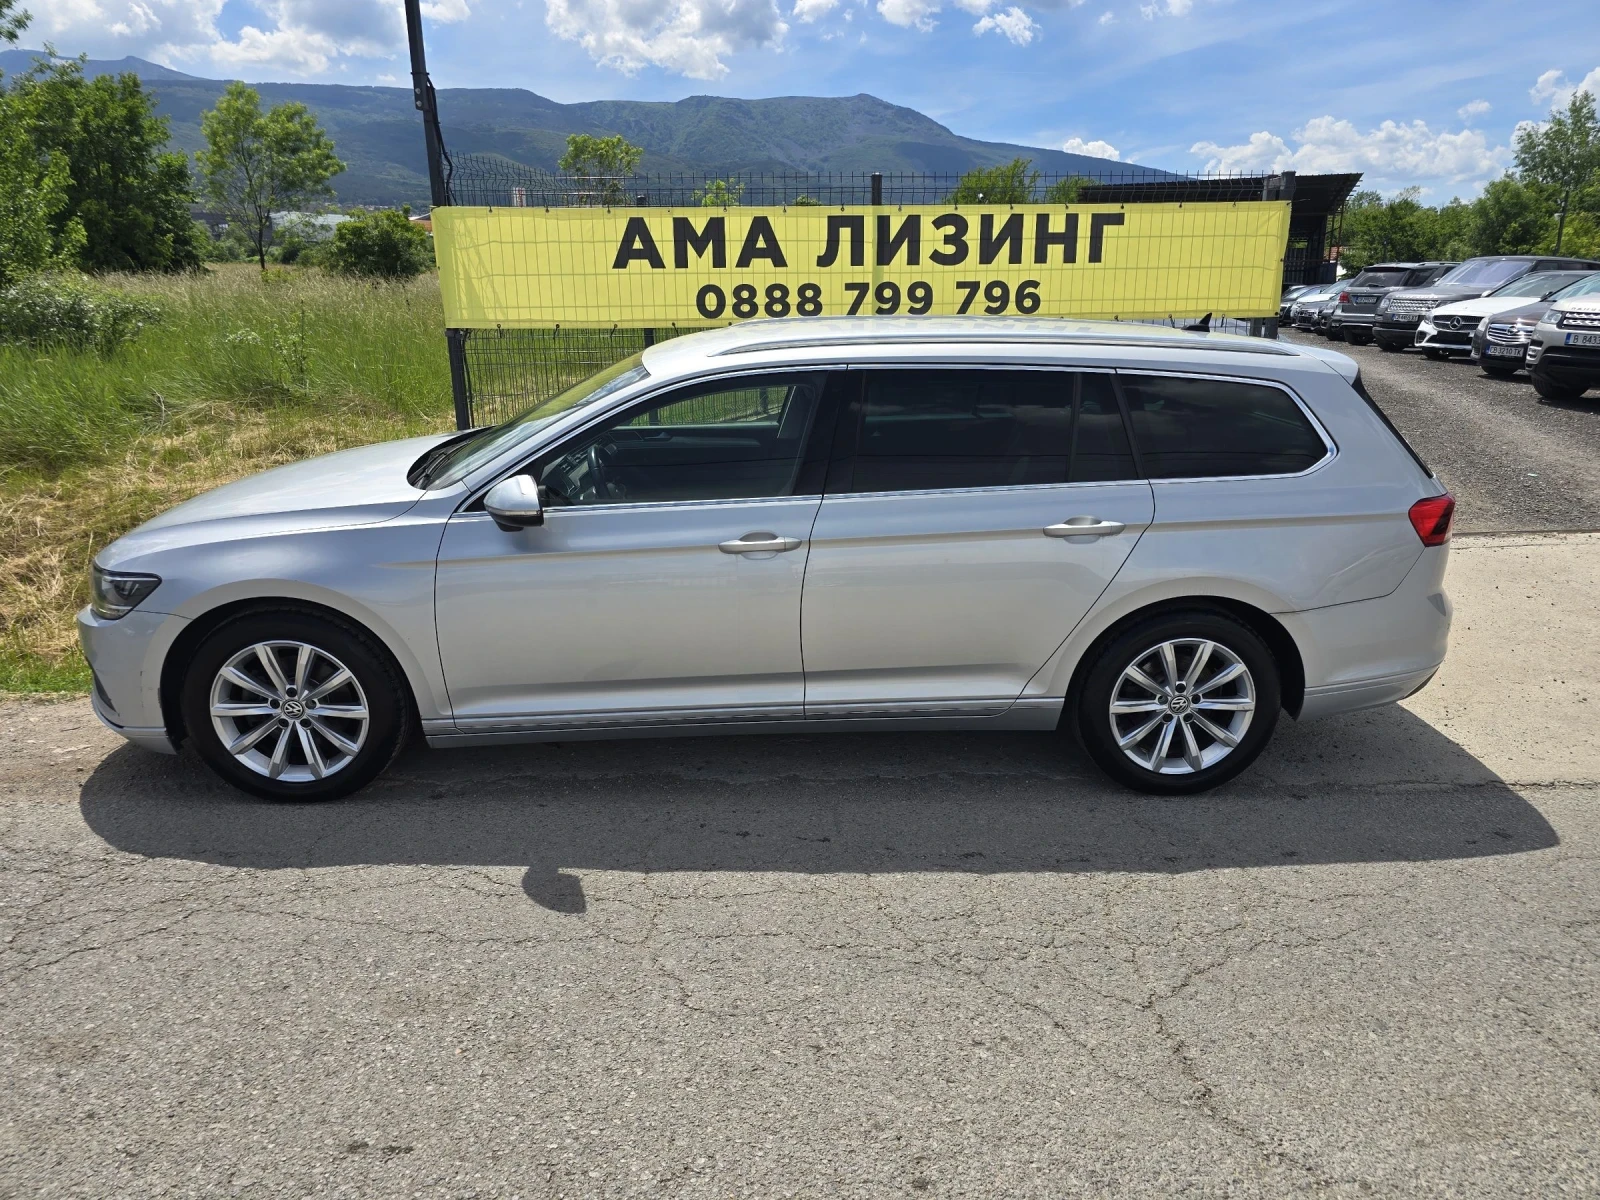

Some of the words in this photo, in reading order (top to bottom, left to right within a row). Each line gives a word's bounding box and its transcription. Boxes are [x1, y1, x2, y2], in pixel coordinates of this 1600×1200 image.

[613, 216, 787, 269] АМА
[817, 212, 1125, 268] ЛИЗИНГ
[697, 282, 822, 319] 0888
[845, 280, 933, 316] 799
[956, 279, 1041, 315] 796
